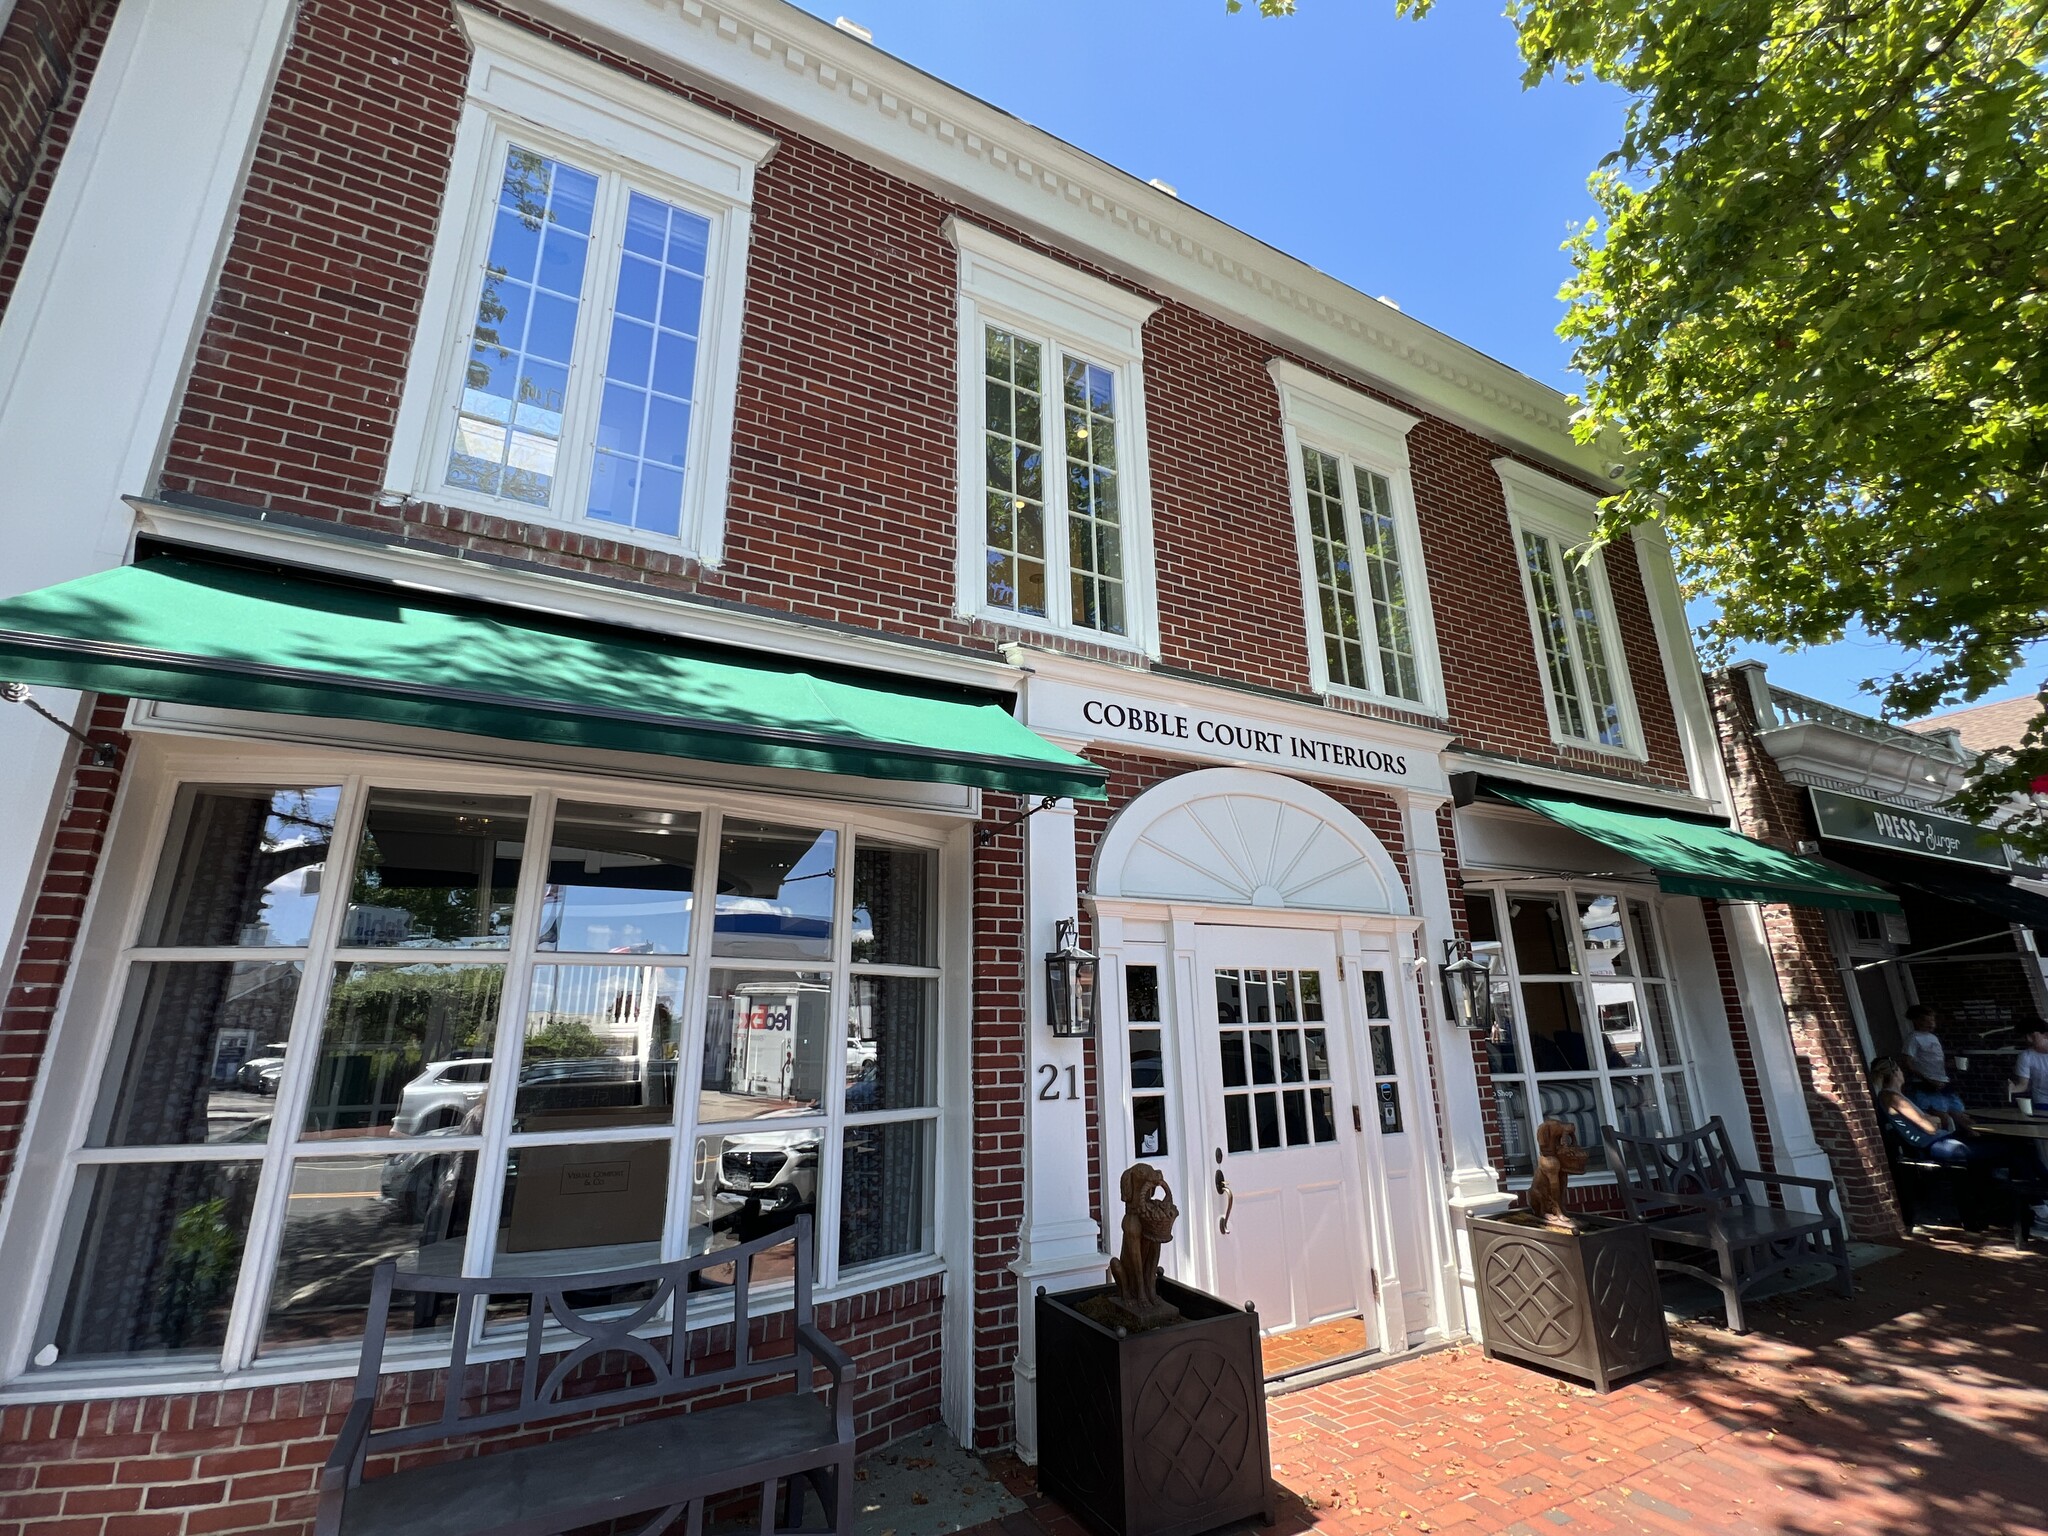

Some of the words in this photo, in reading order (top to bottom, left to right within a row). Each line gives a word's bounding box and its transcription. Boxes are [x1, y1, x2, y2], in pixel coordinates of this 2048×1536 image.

[1083, 701, 1189, 739] COBBLE
[1197, 721, 1282, 754] COURT
[1291, 737, 1407, 775] INTERIORS
[1038, 1064, 1080, 1100] 21
